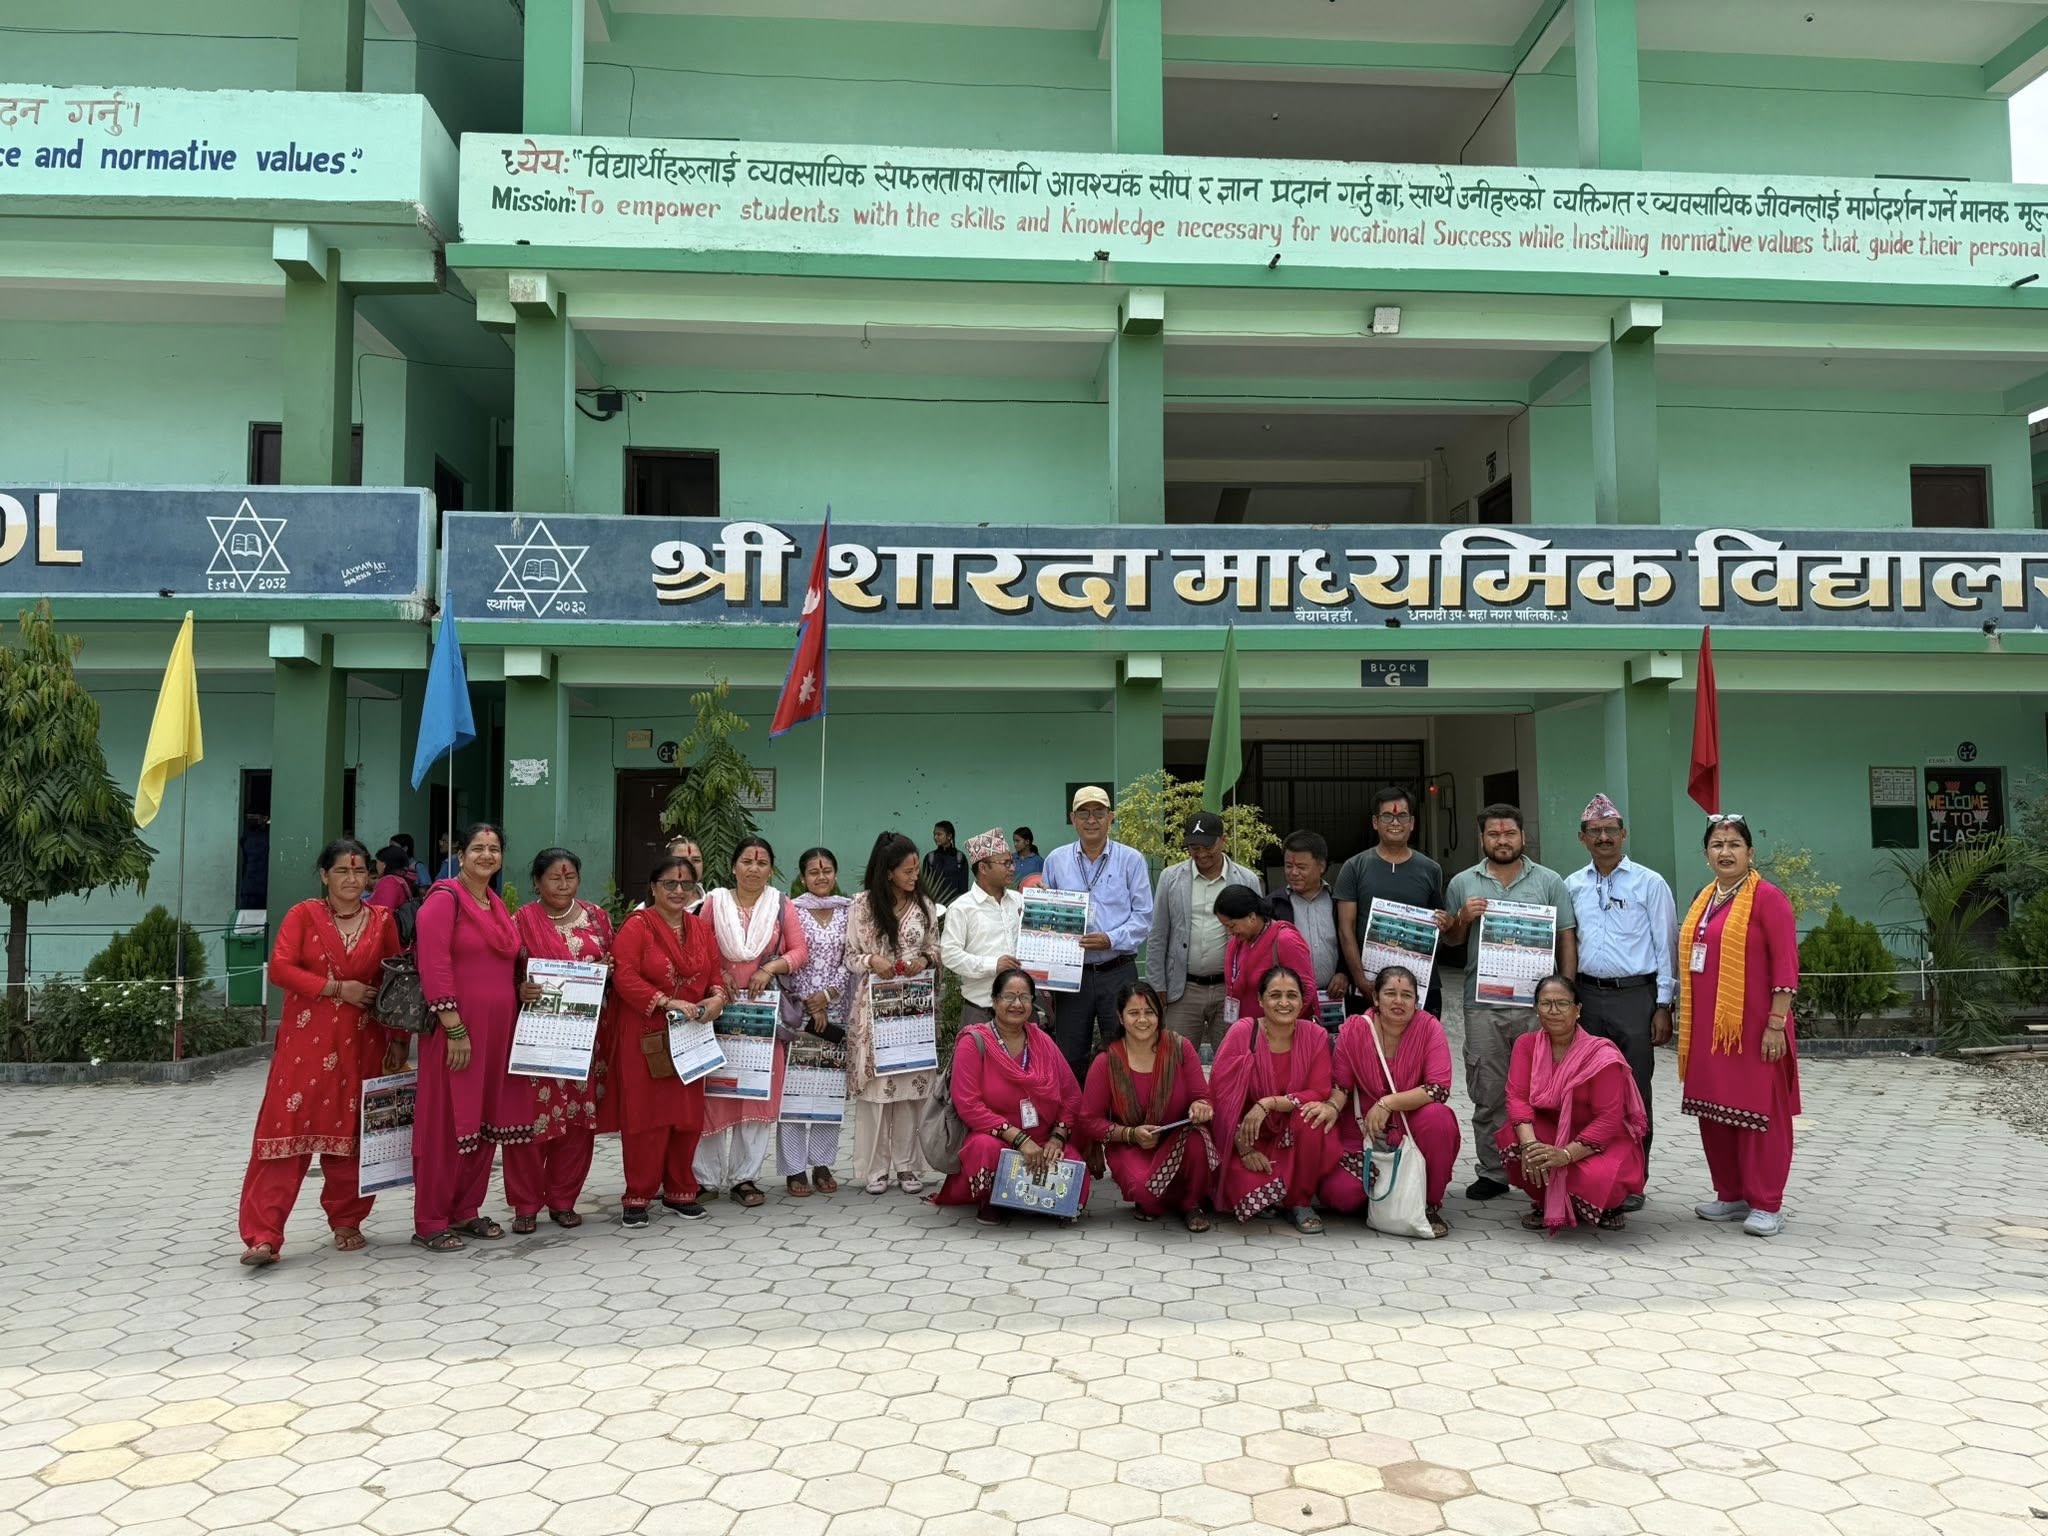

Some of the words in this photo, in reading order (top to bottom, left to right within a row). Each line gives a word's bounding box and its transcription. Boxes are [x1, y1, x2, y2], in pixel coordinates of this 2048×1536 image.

[0, 98, 49, 131] दन
[35, 138, 83, 168] and
[101, 140, 236, 171] normative
[1198, 177, 1214, 205] र
[1217, 178, 1264, 205] ज्ञान
[1637, 192, 1649, 215] र
[1928, 187, 1958, 222] गर्ने
[1960, 200, 2010, 223] मानक
[491, 185, 577, 214] Mission:
[617, 199, 722, 225] empower
[740, 197, 839, 224] students
[853, 201, 898, 228] with
[907, 201, 940, 228] the
[951, 204, 1006, 231] skills
[1017, 206, 1050, 233] and
[1061, 205, 1165, 244] Knowledge
[1177, 220, 1282, 247] necessary
[1292, 215, 1320, 242] for
[1330, 219, 1426, 245] vocational
[1433, 219, 1511, 248] Success
[1519, 223, 1564, 249] while
[1573, 222, 1649, 258] Instilling
[1661, 226, 1752, 253] normative
[1757, 228, 1814, 254] values
[1822, 227, 1860, 254] that
[1866, 230, 1914, 260] guide
[1919, 230, 1962, 255] their
[1970, 234, 2046, 267] personal
[341, 561, 373, 579] LAXMAN
[651, 521, 796, 602] श्री
[828, 543, 1159, 618] शारदा
[1170, 527, 1677, 607] माध्यमिक
[1688, 528, 2048, 608] विद्याल
[207, 577, 236, 591] Estd
[258, 576, 287, 591] 2032
[486, 597, 525, 613] स्थापित
[556, 600, 586, 615] २०३२
[1370, 662, 1417, 674] BLOCK
[1384, 673, 1401, 687] G
[1927, 795, 1989, 810] WELCOME
[1950, 812, 1973, 826] TO
[1930, 828, 1989, 843] CLASS
